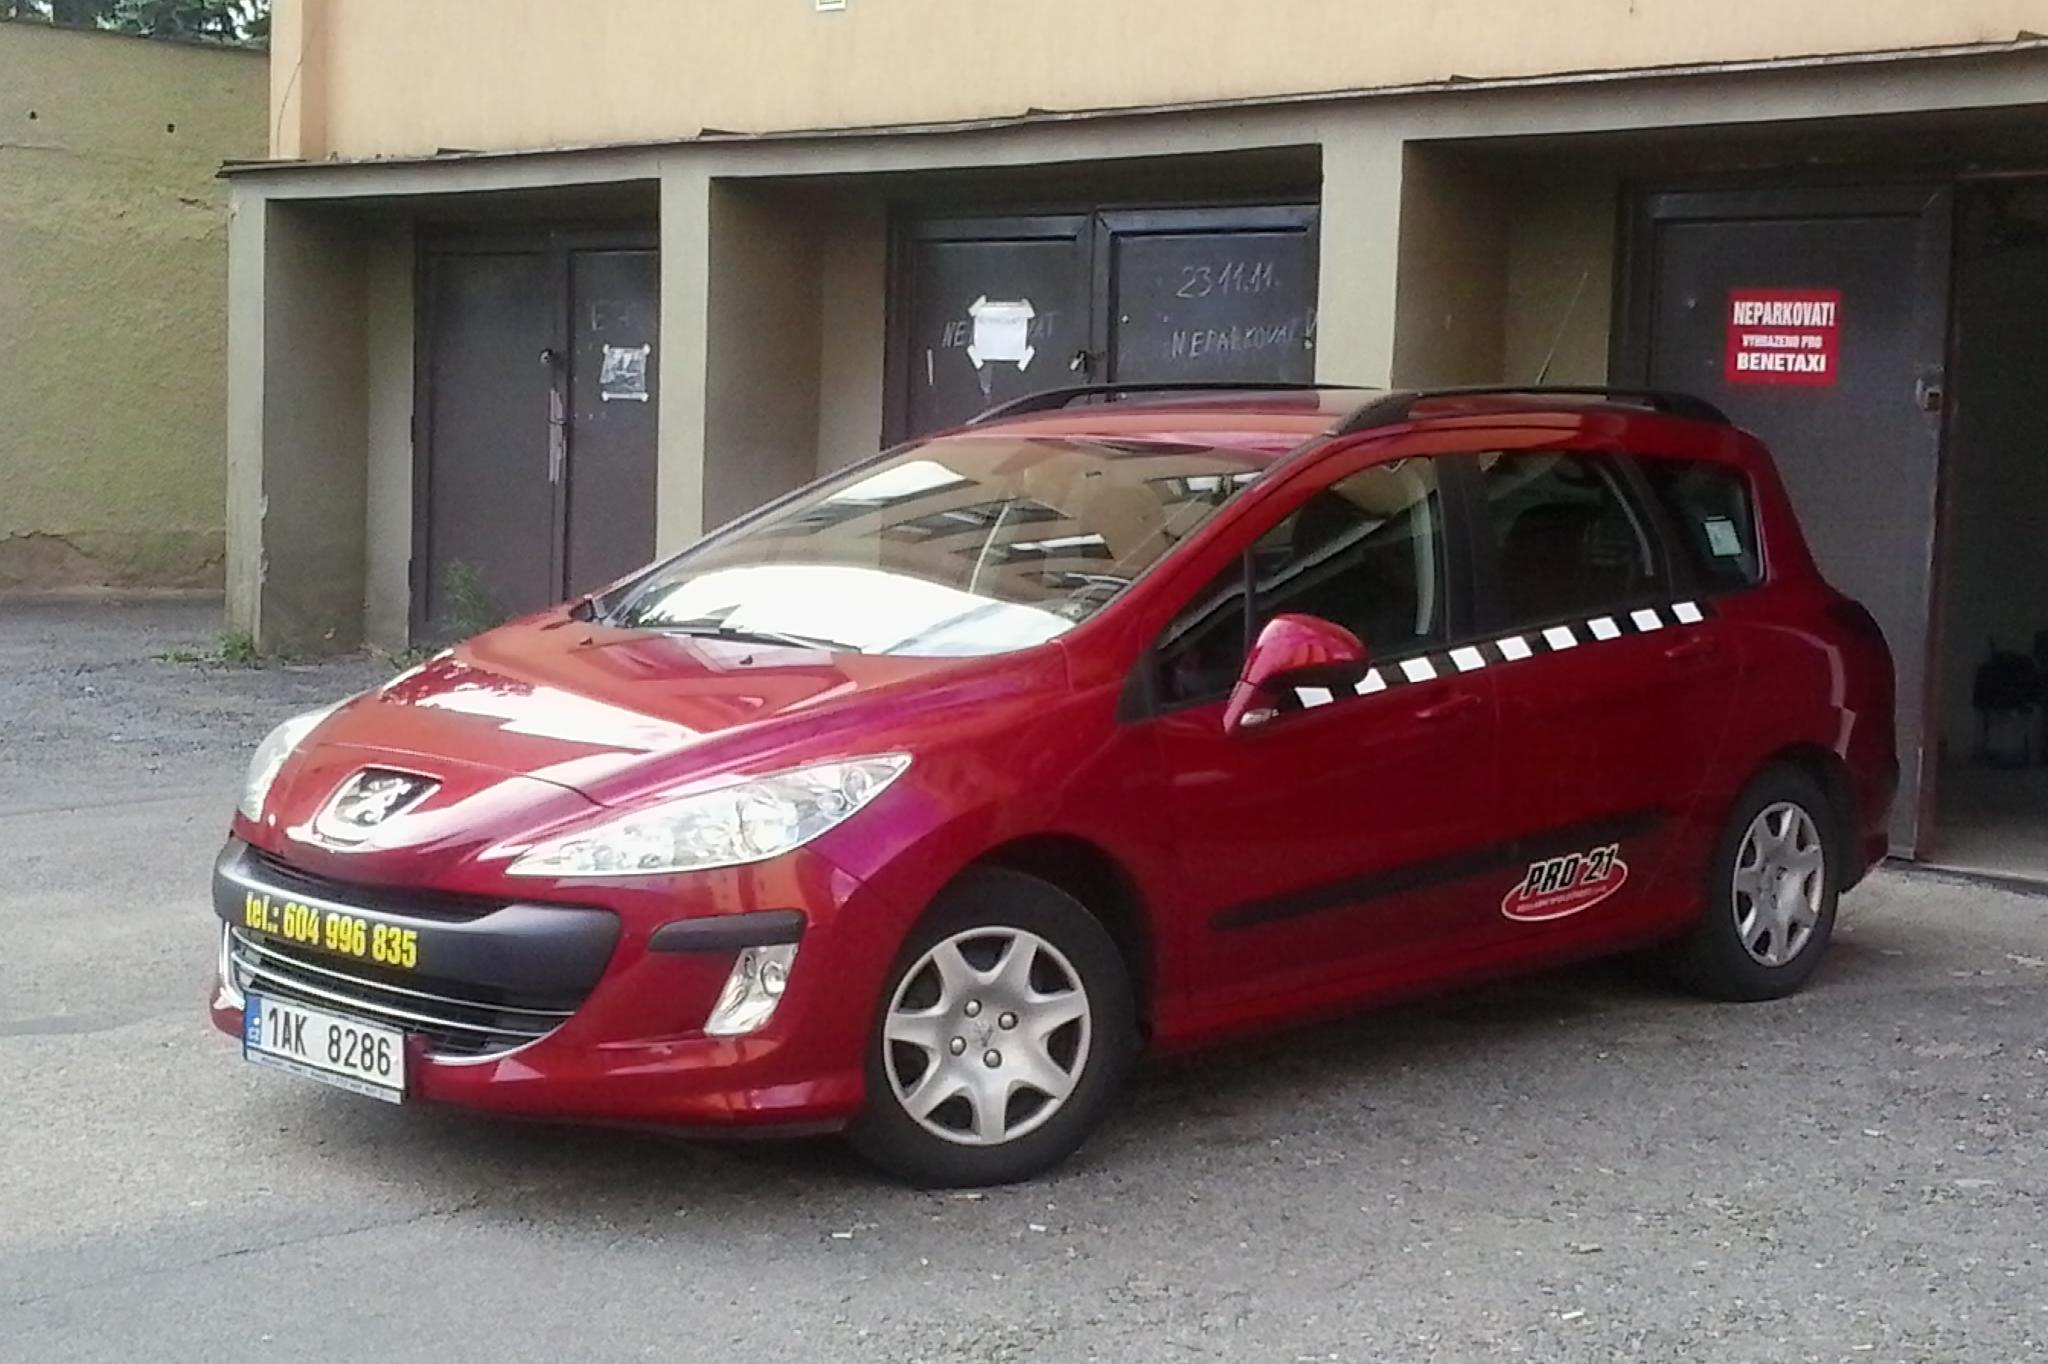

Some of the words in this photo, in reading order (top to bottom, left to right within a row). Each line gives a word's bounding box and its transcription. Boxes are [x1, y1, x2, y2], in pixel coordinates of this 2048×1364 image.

[1733, 301, 1836, 327] NEPARKOVAT!
[1737, 352, 1826, 372] BENETAXI
[1519, 853, 1582, 900] PRO
[1581, 843, 1619, 884] 21
[246, 891, 279, 933] tel.:
[283, 902, 320, 945] 604
[325, 913, 367, 956] 996
[372, 924, 417, 967] 835
[268, 1007, 309, 1057] 1AK
[327, 1024, 392, 1077] 8286
